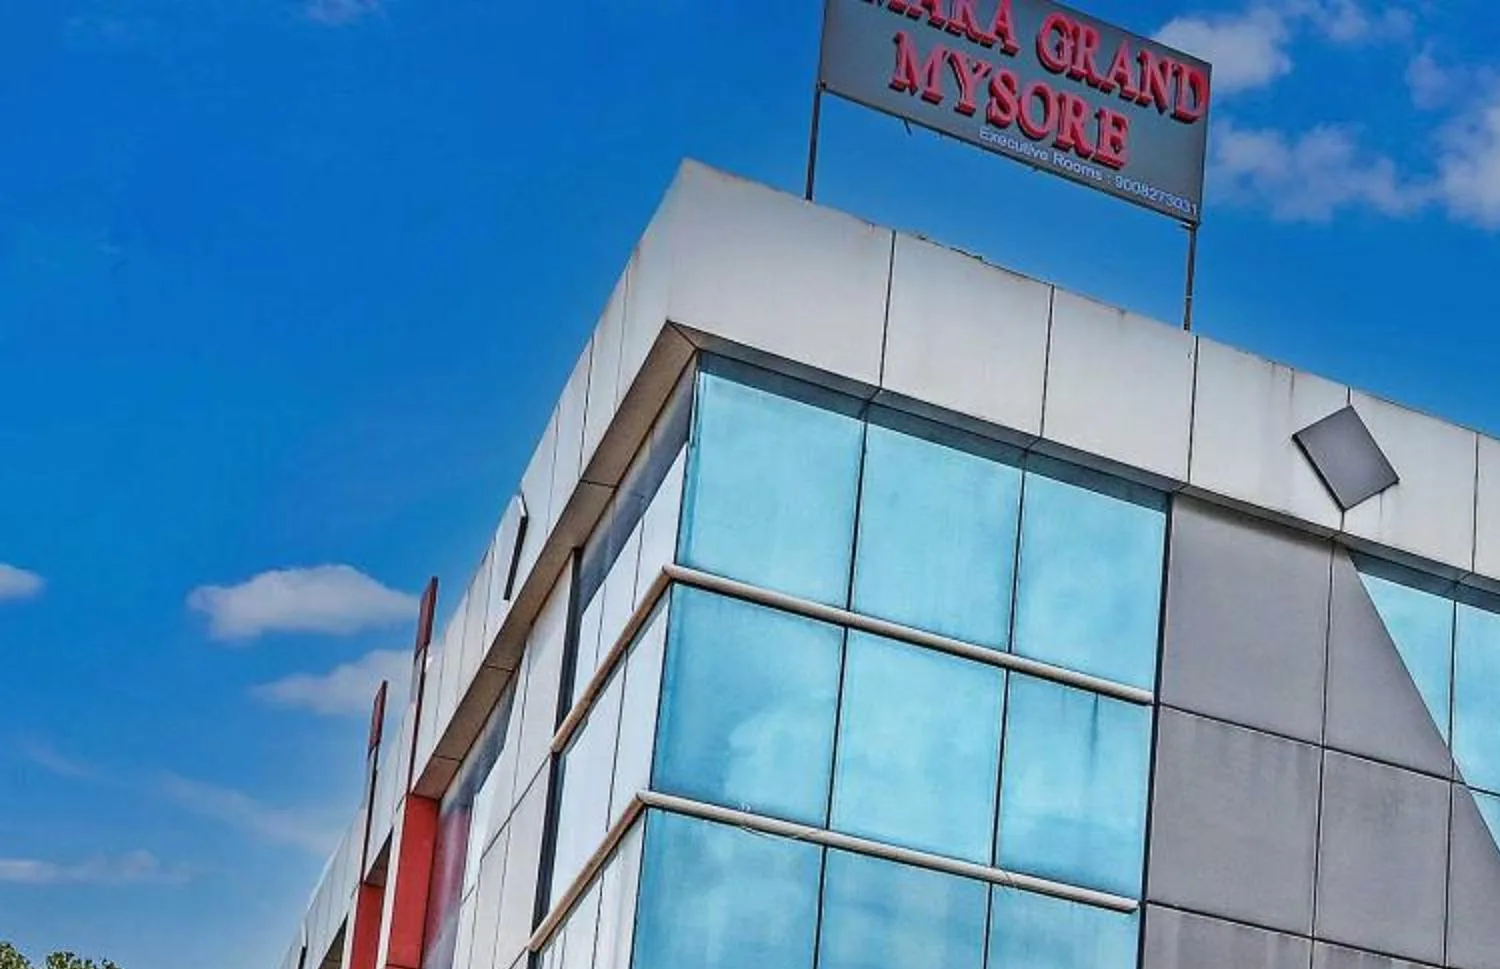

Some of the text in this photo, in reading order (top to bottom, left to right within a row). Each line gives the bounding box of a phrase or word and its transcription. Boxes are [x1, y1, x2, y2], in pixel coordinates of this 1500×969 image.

[888, 30, 1131, 171] MYSORE
[1035, 11, 1211, 124] GRAND
[978, 126, 1049, 161] Executive
[1052, 150, 1104, 182] Rooms
